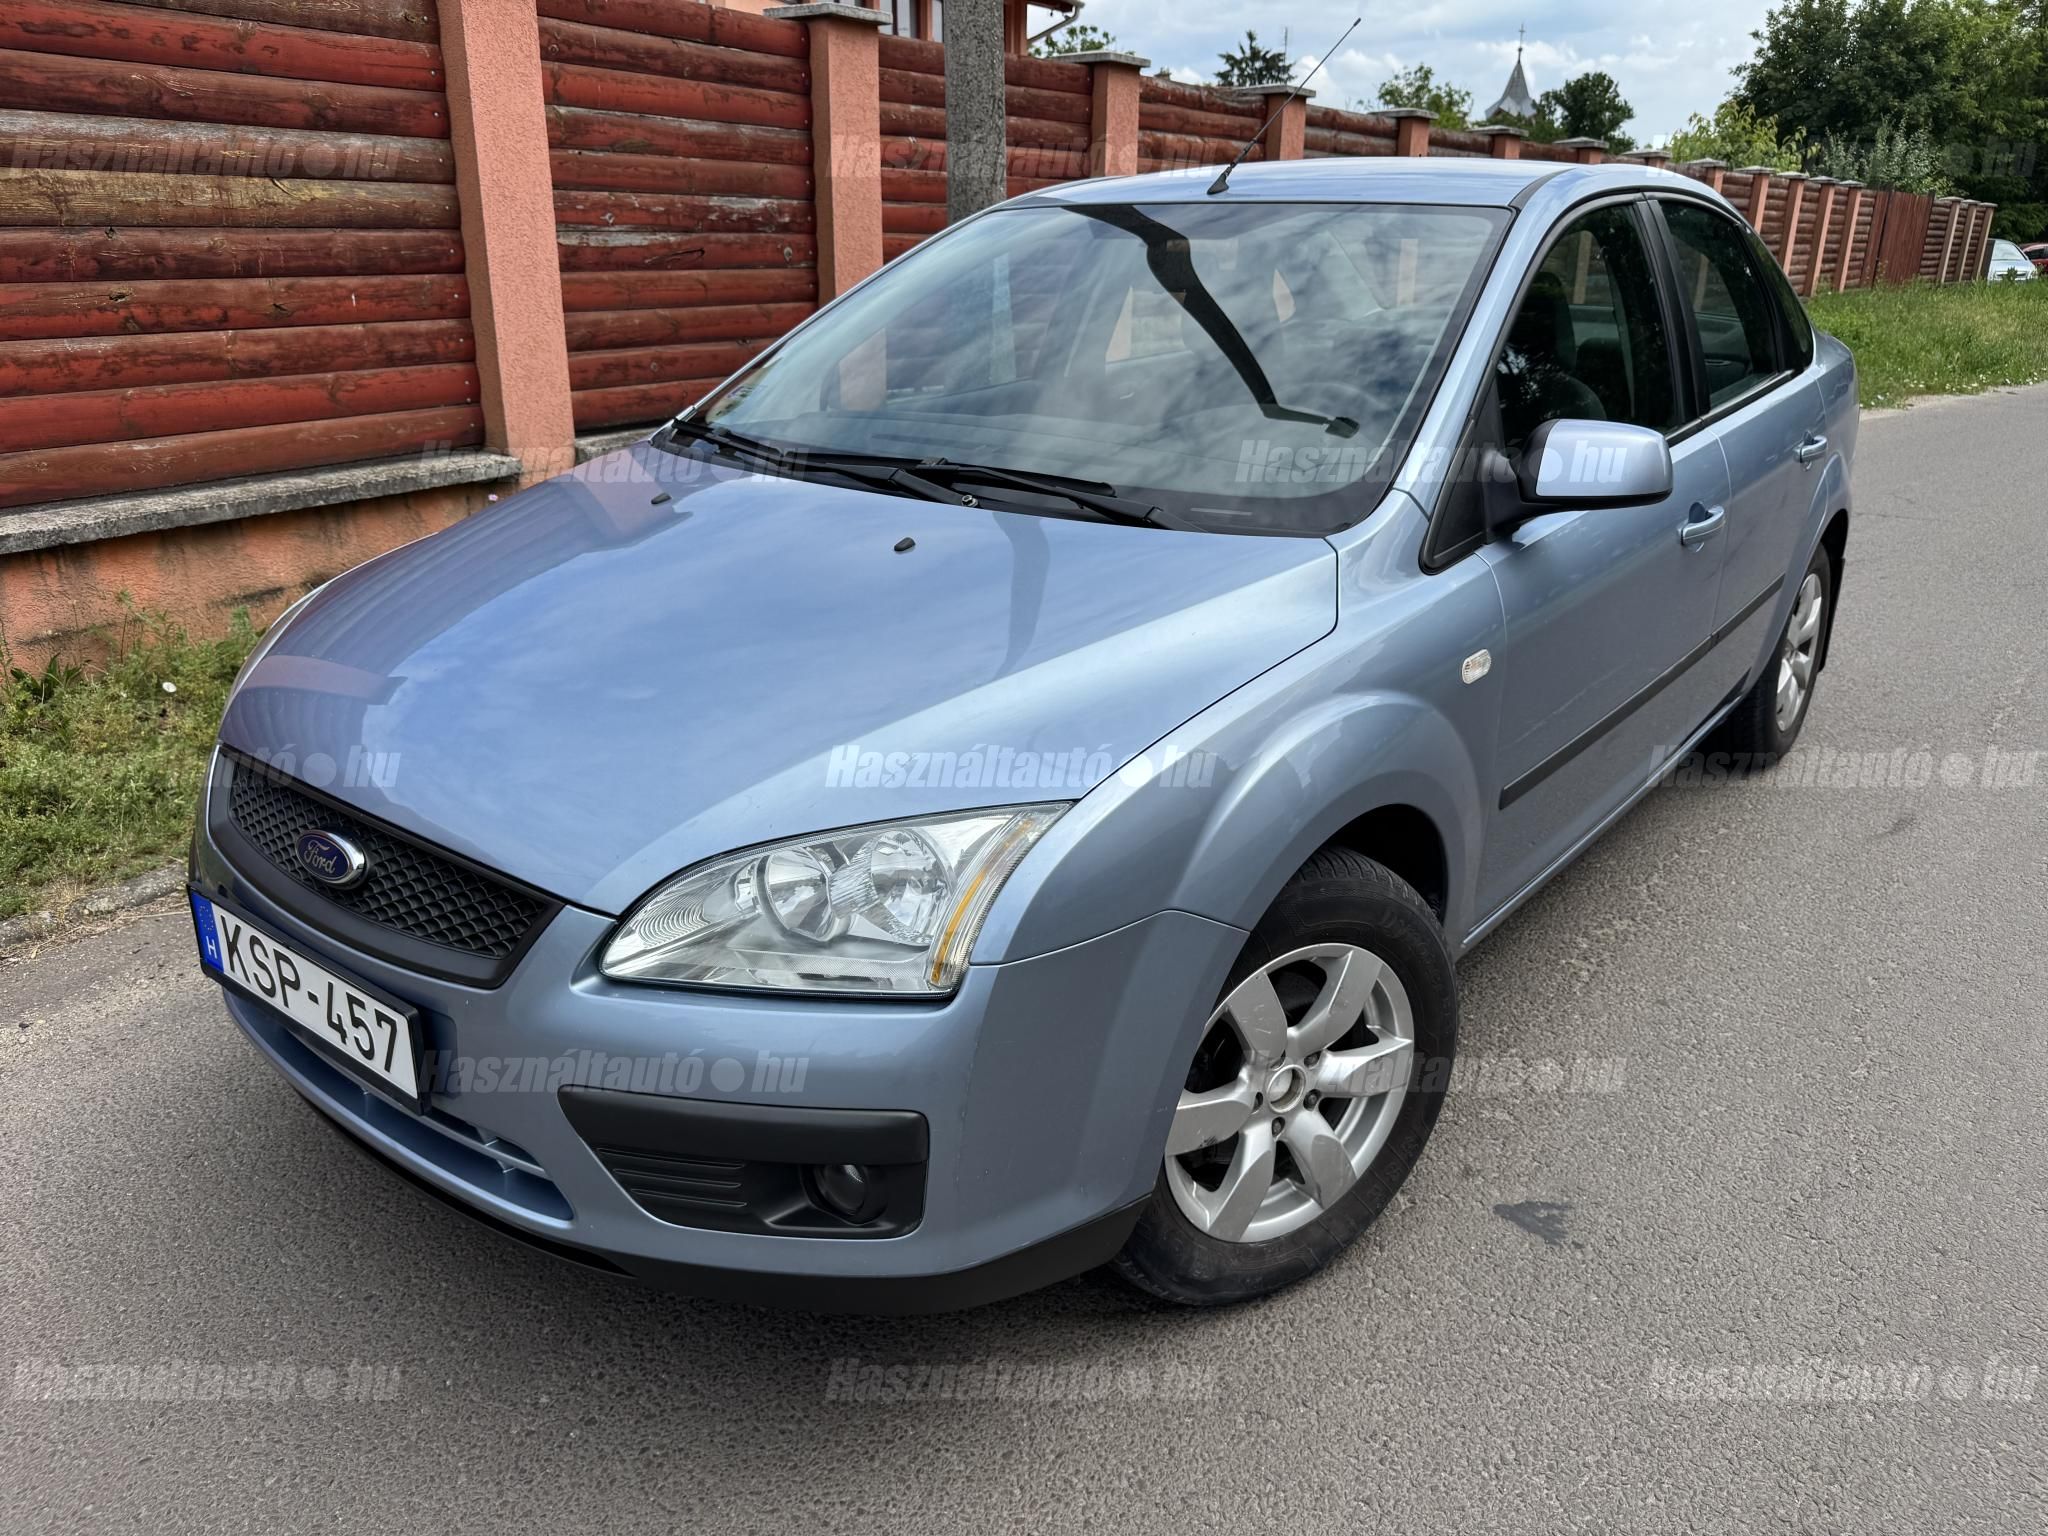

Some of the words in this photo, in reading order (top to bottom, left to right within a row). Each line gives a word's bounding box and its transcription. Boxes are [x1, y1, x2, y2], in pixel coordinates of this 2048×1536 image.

[303, 840, 338, 874] Ford
[205, 936, 218, 959] H
[220, 914, 398, 1073] KSP-457
